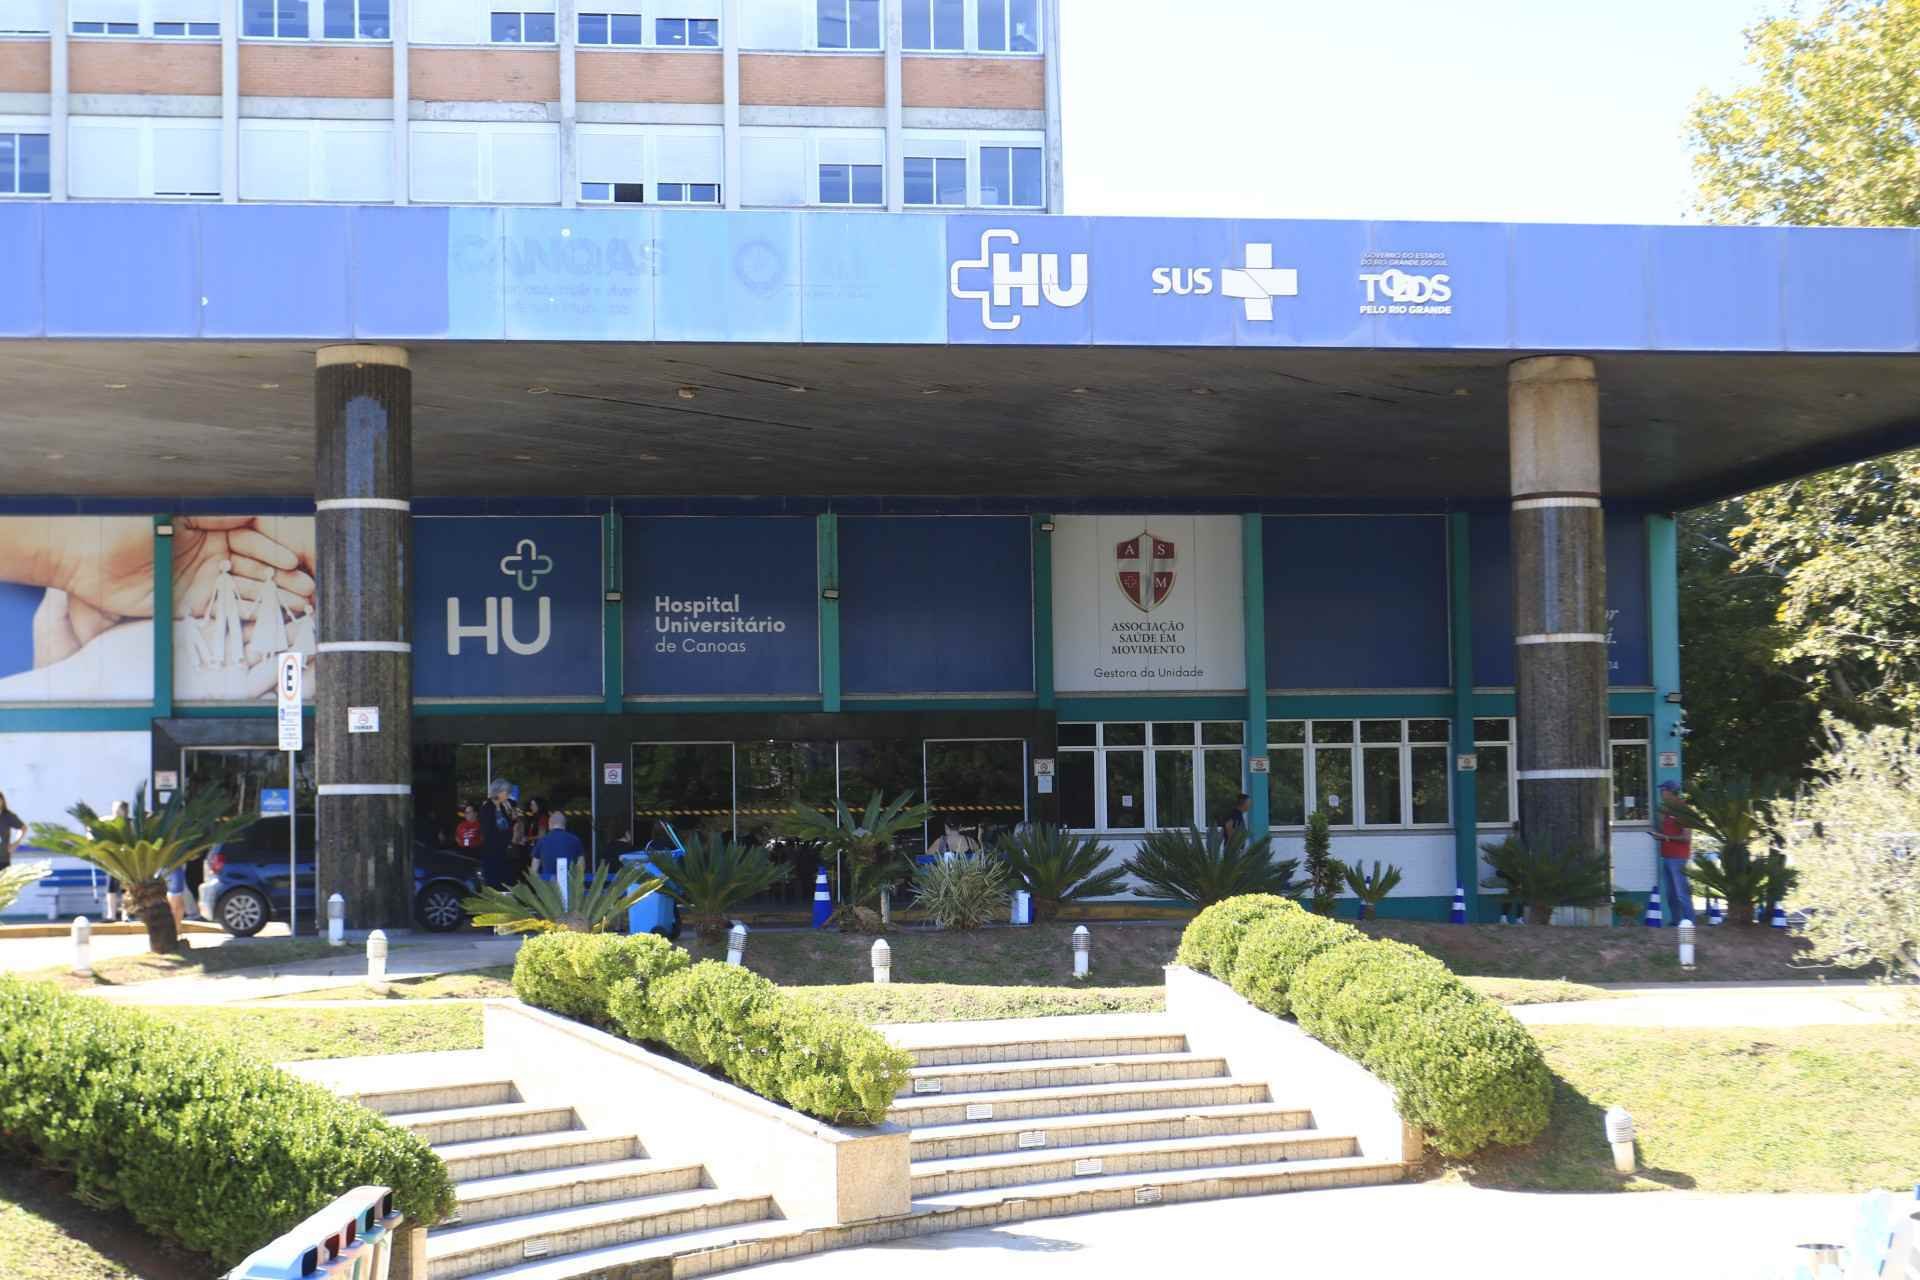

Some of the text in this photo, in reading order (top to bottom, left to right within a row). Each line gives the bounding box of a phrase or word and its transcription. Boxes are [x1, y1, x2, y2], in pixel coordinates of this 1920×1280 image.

[1152, 267, 1213, 295] SUS
[1360, 306, 1452, 314] PELO RIO GRANDE
[1124, 544, 1166, 555] A S
[1155, 577, 1167, 588] M
[655, 594, 740, 617] Hospital
[446, 596, 551, 656] HU
[655, 614, 786, 634] Universitário
[1111, 620, 1184, 633] ASSOCIAÇÃO
[1119, 632, 1176, 643] SAÚDE EM
[655, 638, 747, 653] de Canoas
[1111, 645, 1185, 655] MOVIMENTO
[1094, 666, 1203, 679] Gestora da Unidade
